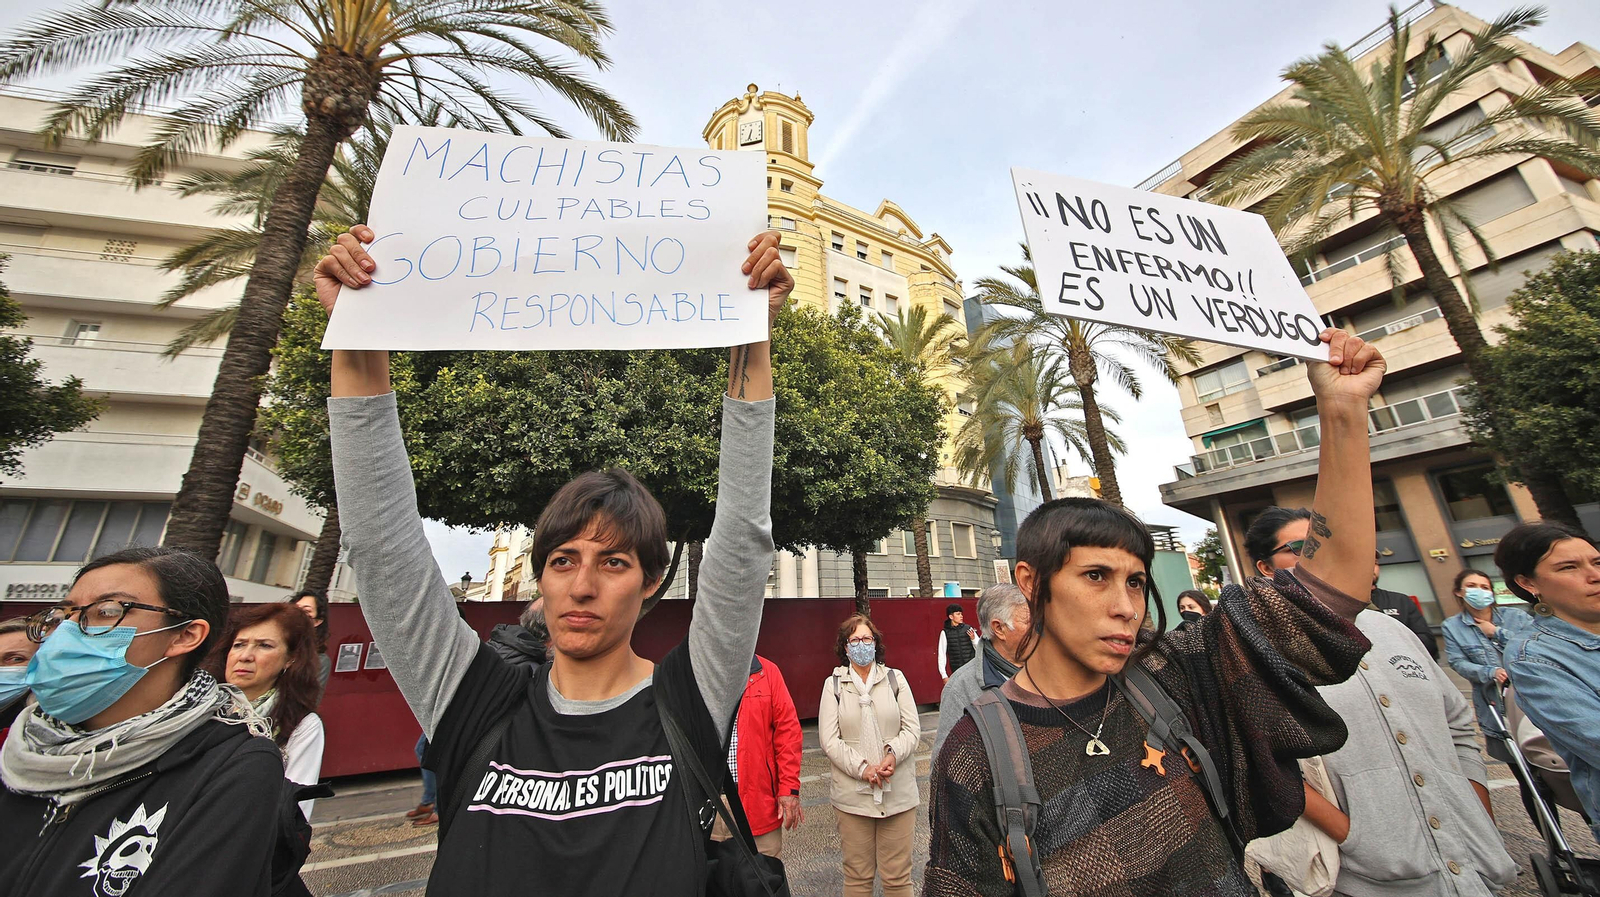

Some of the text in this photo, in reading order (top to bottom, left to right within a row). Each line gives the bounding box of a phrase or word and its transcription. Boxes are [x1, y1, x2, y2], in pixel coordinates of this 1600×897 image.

[403, 137, 721, 187] MACHISTAS
[458, 196, 711, 221] CULPABLES
[1128, 204, 1174, 245] ES
[1177, 213, 1229, 256] UN
[366, 232, 686, 286] GOBIERNO
[1069, 241, 1258, 301] ENFERMO!!
[469, 291, 741, 333] RESPONSABLE
[1058, 272, 1321, 347] ES UN VERDUGO
[6, 584, 57, 593] BOLSOS
[575, 775, 600, 807] ES
